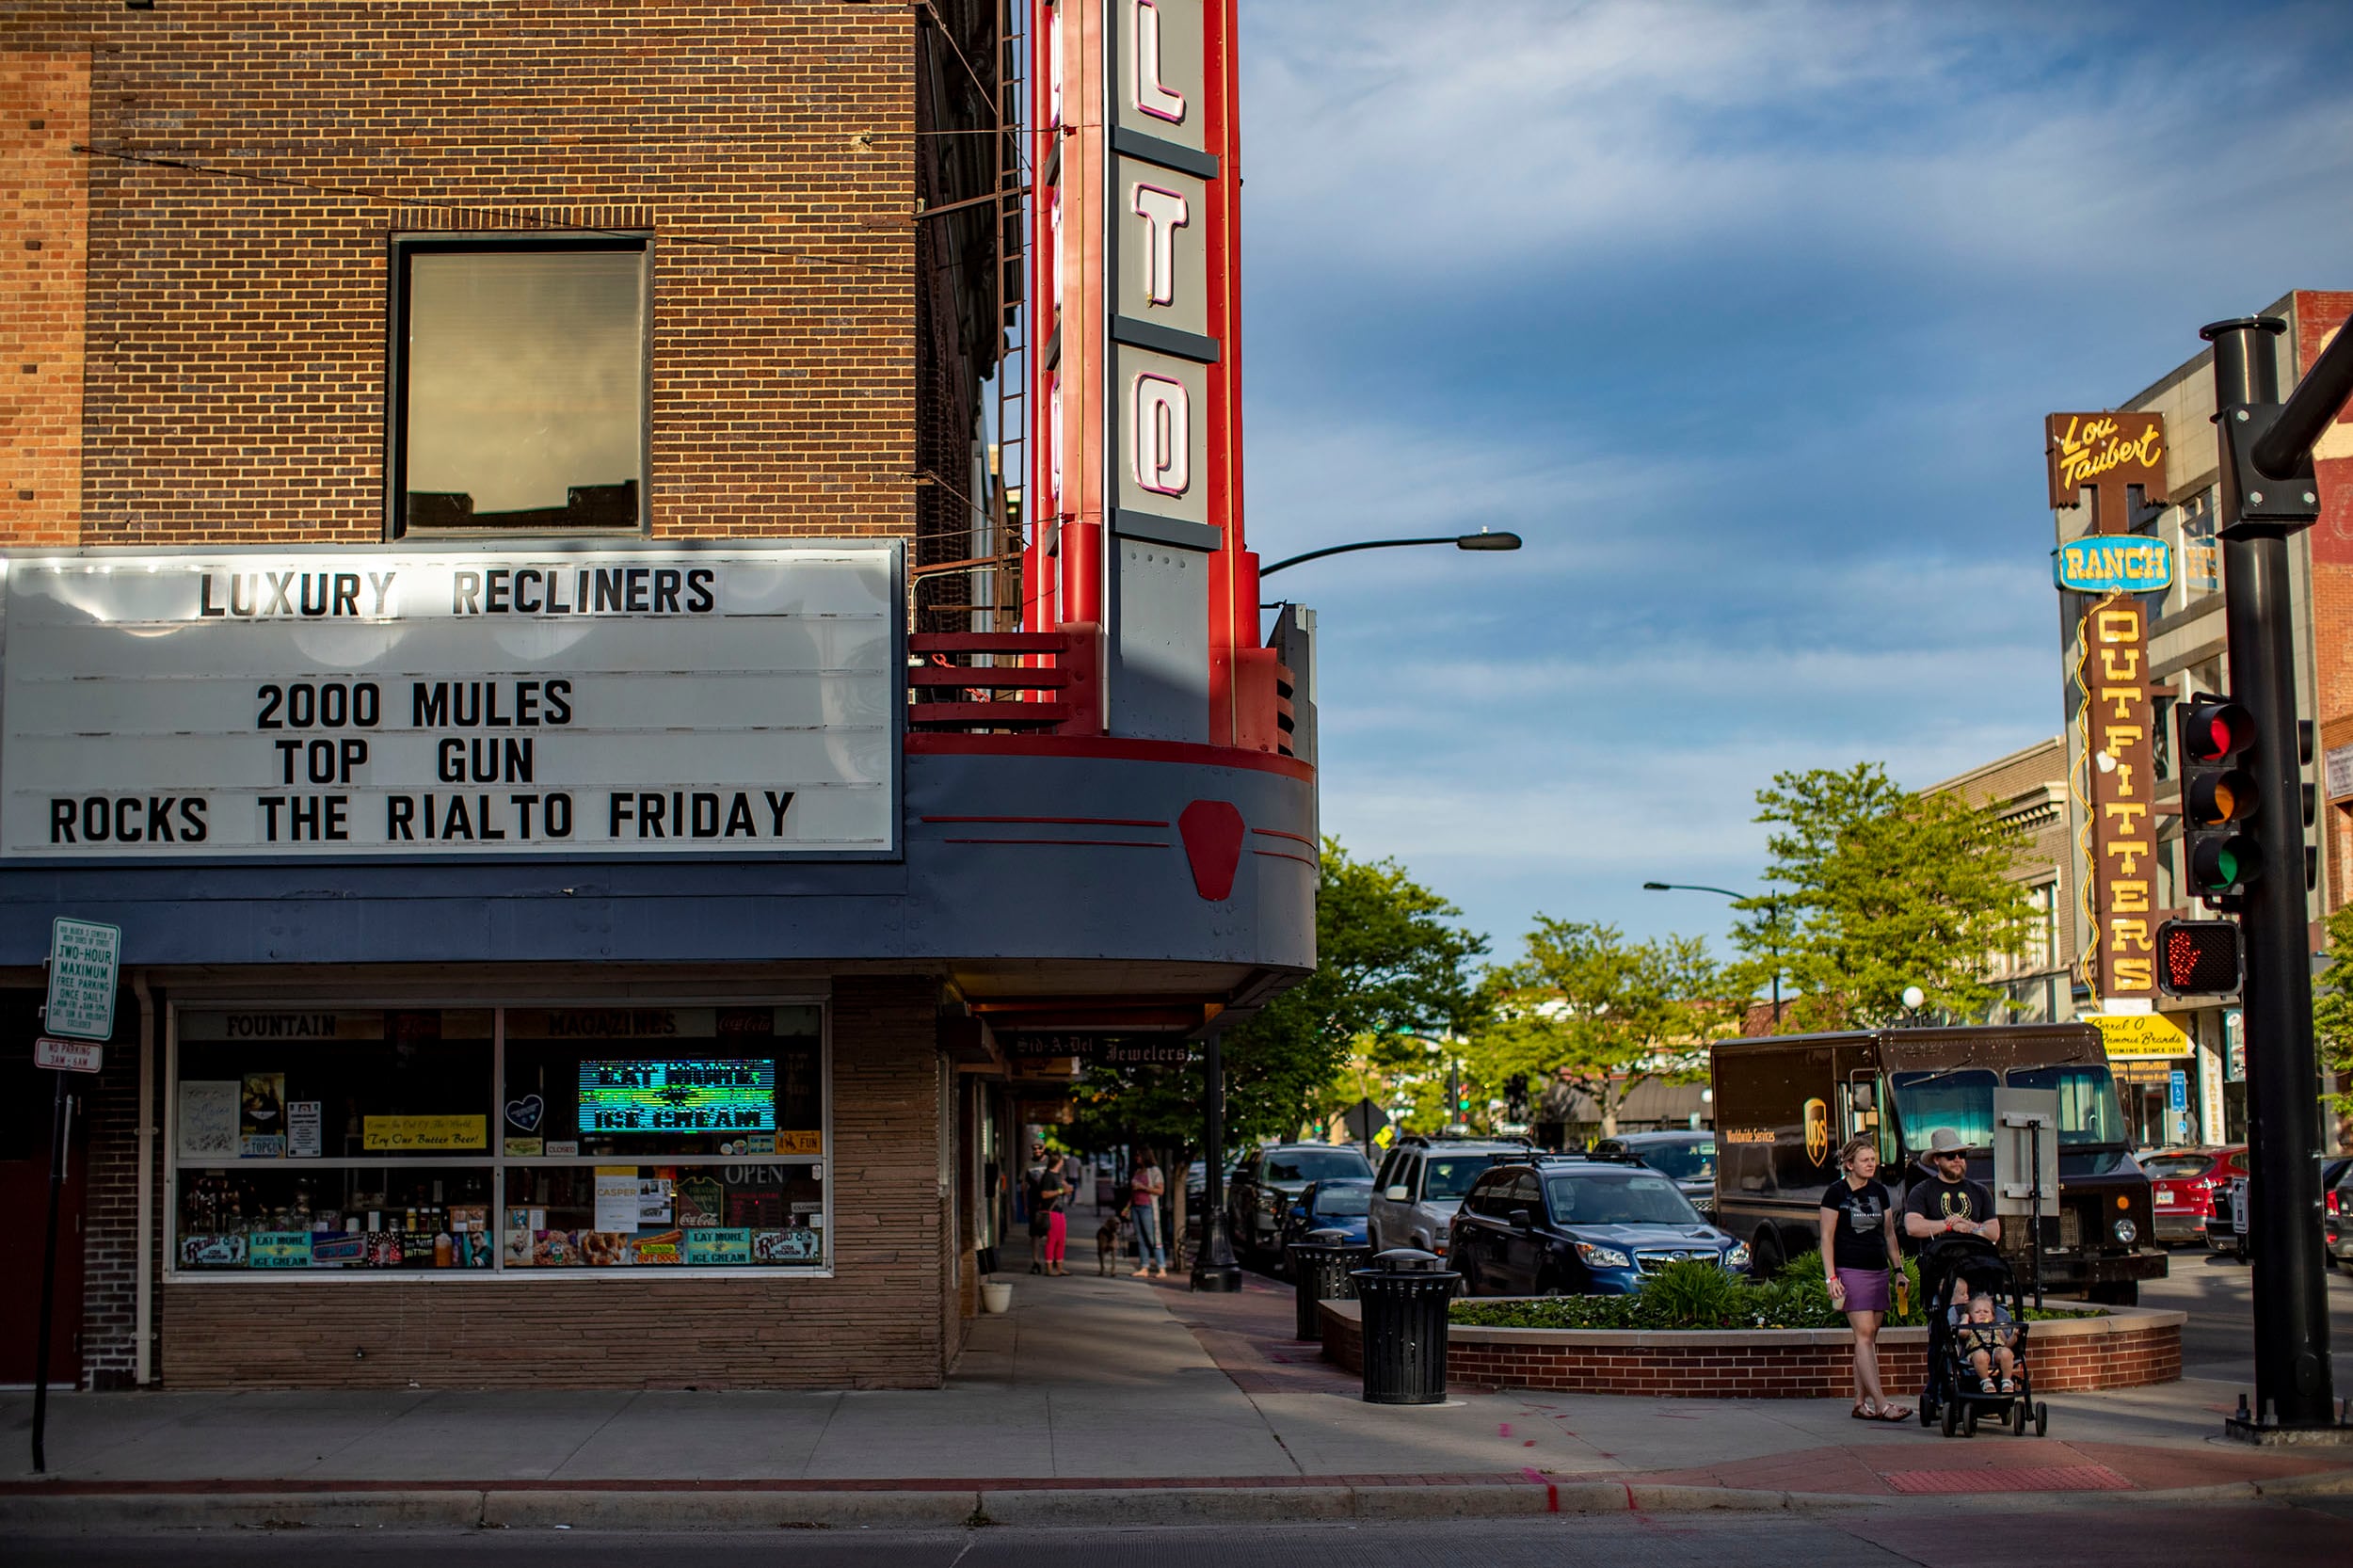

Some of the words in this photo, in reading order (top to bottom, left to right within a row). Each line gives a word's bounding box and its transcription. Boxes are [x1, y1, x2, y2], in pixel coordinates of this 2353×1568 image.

[2061, 416, 2119, 456] Lou
[2060, 424, 2162, 490] Taubert
[2065, 547, 2167, 581] RANCH
[200, 570, 397, 616] LUXURY
[453, 568, 715, 615] RECLINERS
[257, 682, 380, 729] 2000
[412, 680, 572, 728] MULES
[276, 738, 369, 785] TOP
[438, 737, 534, 783] GUN
[2098, 610, 2153, 991] OUTFITTERS
[50, 797, 208, 843] ROCKS
[258, 795, 348, 841] THE
[387, 792, 573, 840] RIALTO
[609, 791, 795, 839] FRIDAY
[58, 945, 112, 965] TWO-HOUR
[60, 962, 108, 980] MAXIMUM
[56, 976, 74, 987] FREE
[78, 979, 110, 992] PARKING
[59, 988, 79, 1000] ONCE
[83, 991, 104, 1002] DAILY
[227, 1015, 337, 1037] FOUNTAIN
[548, 1011, 677, 1035] MAGAZINES
[2134, 1016, 2146, 1031] O
[2141, 1032, 2182, 1045] Brands
[48, 1043, 58, 1053] NO
[61, 1044, 91, 1056] PARKING
[1105, 1043, 1187, 1062] Jewelers
[50, 1055, 65, 1065] 3AM
[595, 1109, 641, 1128] ICE
[652, 1109, 761, 1128] CREAM
[392, 1133, 413, 1144] Our
[416, 1133, 448, 1144] Butter
[452, 1133, 479, 1144] Beer!
[799, 1137, 817, 1149] FUN
[1726, 1128, 1753, 1144] Worldwide
[1753, 1128, 1776, 1144] Services
[1806, 1119, 1827, 1158] ups
[724, 1165, 784, 1185] OPEN
[597, 1188, 637, 1197] CASPER
[255, 1237, 274, 1245] EAT
[276, 1236, 304, 1245] MORE
[693, 1233, 712, 1241] EAT
[714, 1232, 744, 1241] MORE
[759, 1231, 792, 1257] Rialto
[186, 1236, 220, 1263] Rialto
[637, 1254, 658, 1263] HOT
[659, 1253, 680, 1263] DOGS
[692, 1253, 709, 1263] ICE
[711, 1253, 746, 1263] CREAM
[254, 1256, 271, 1266] ICE
[272, 1256, 308, 1267] CREAM
